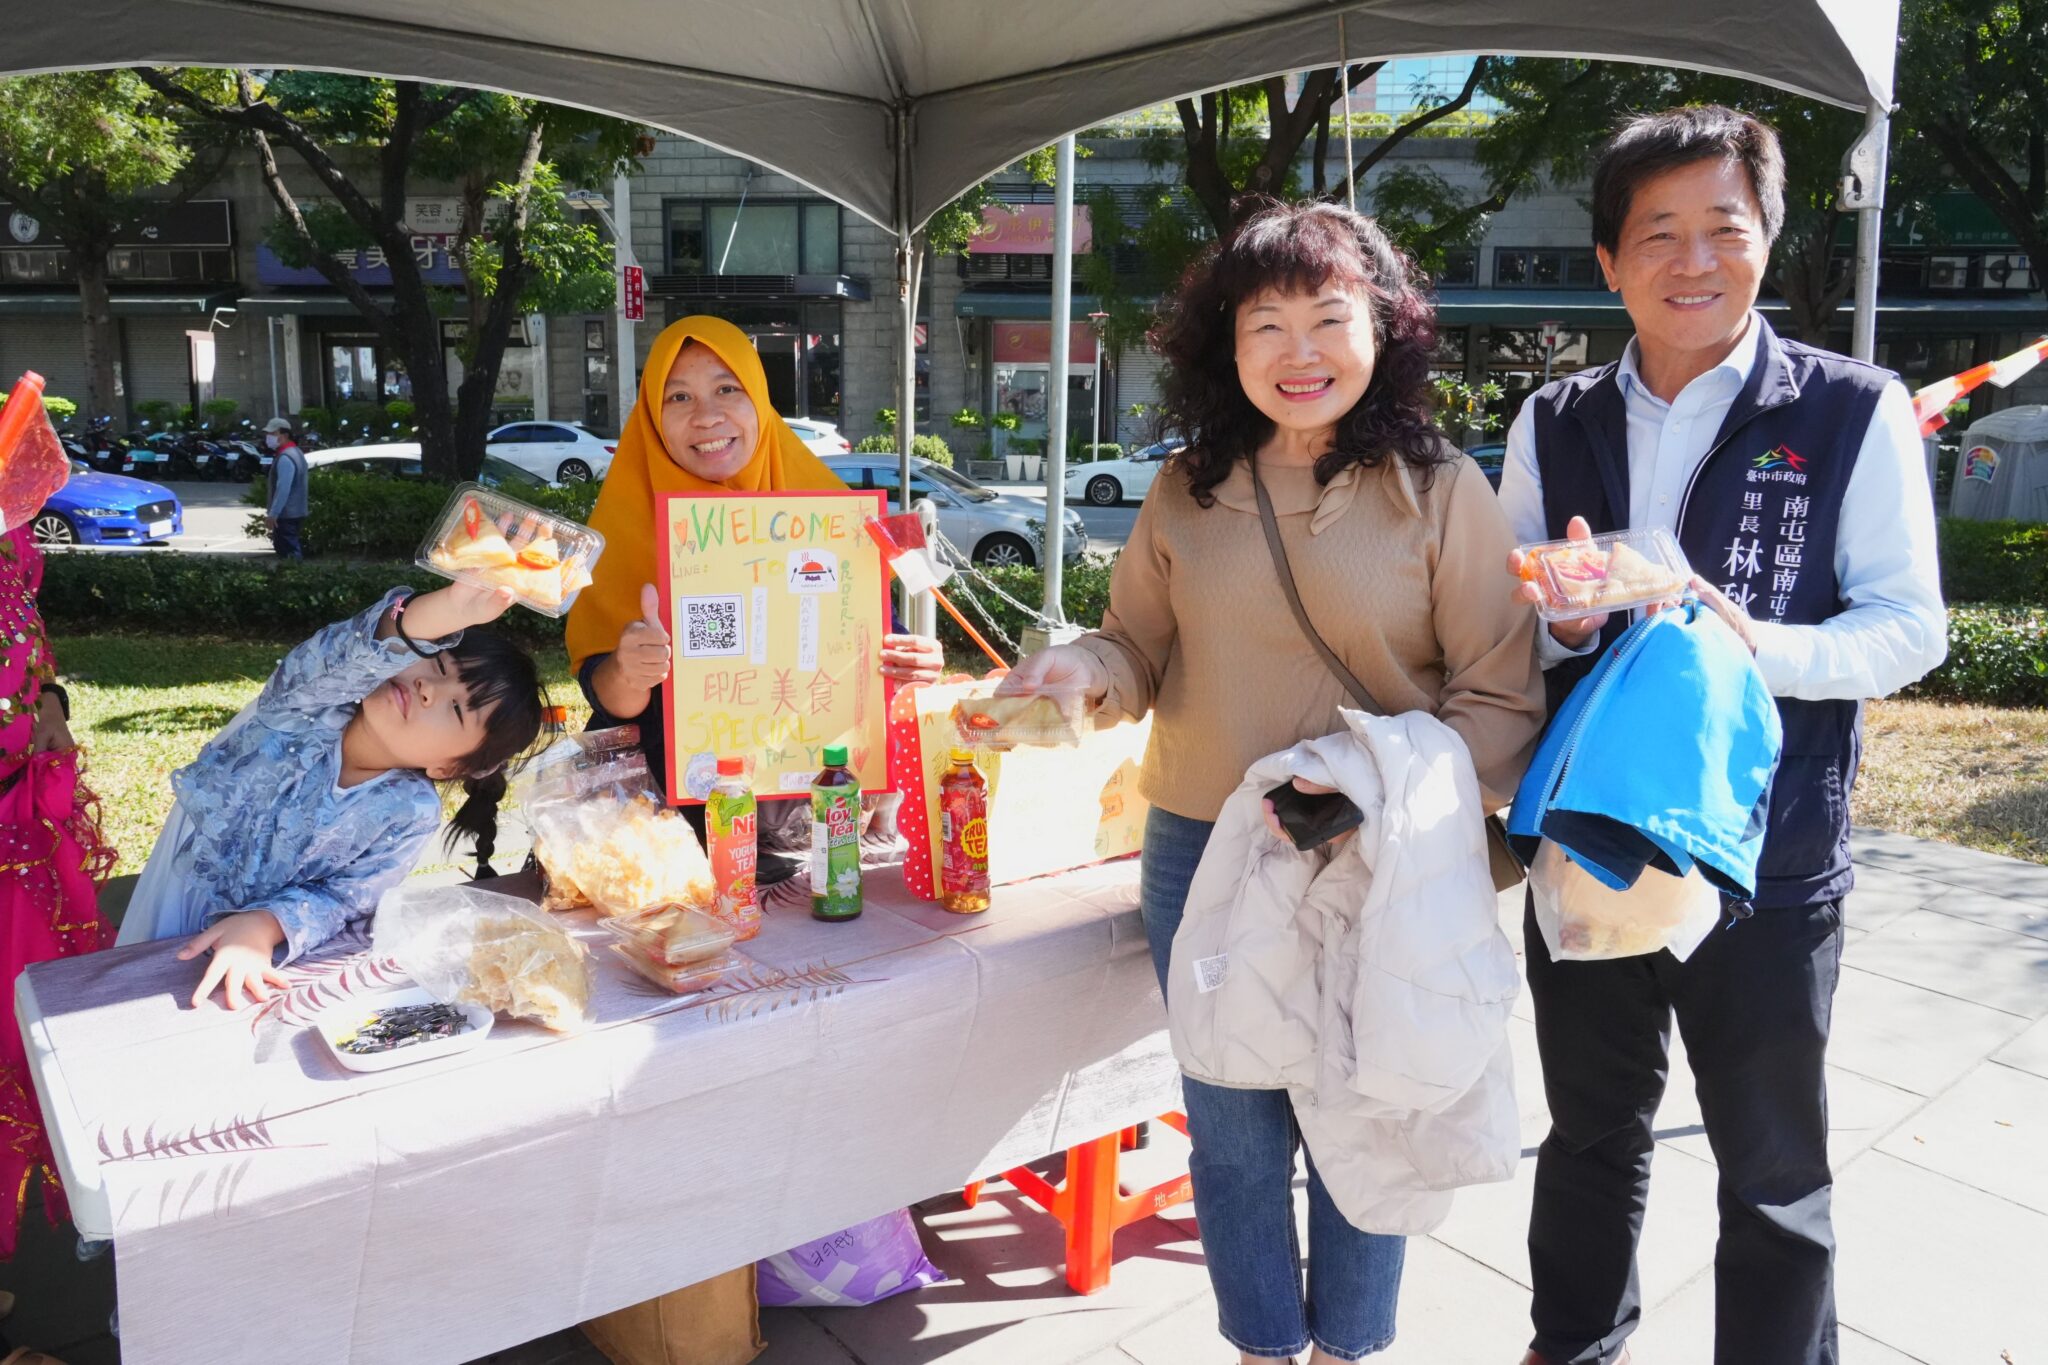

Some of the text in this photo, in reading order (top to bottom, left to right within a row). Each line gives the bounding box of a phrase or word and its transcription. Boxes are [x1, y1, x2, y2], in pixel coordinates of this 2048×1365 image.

[1745, 469, 1808, 486] 臺中市政府
[691, 504, 845, 552] WELCOME
[743, 557, 786, 583] TO
[703, 668, 840, 716] 印尼美食
[684, 712, 820, 753] SPECIAL
[826, 807, 852, 825] Joy
[829, 823, 854, 838] Tea
[964, 822, 988, 841] FRUI
[728, 842, 757, 861] YOGU
[737, 857, 755, 873] TEA
